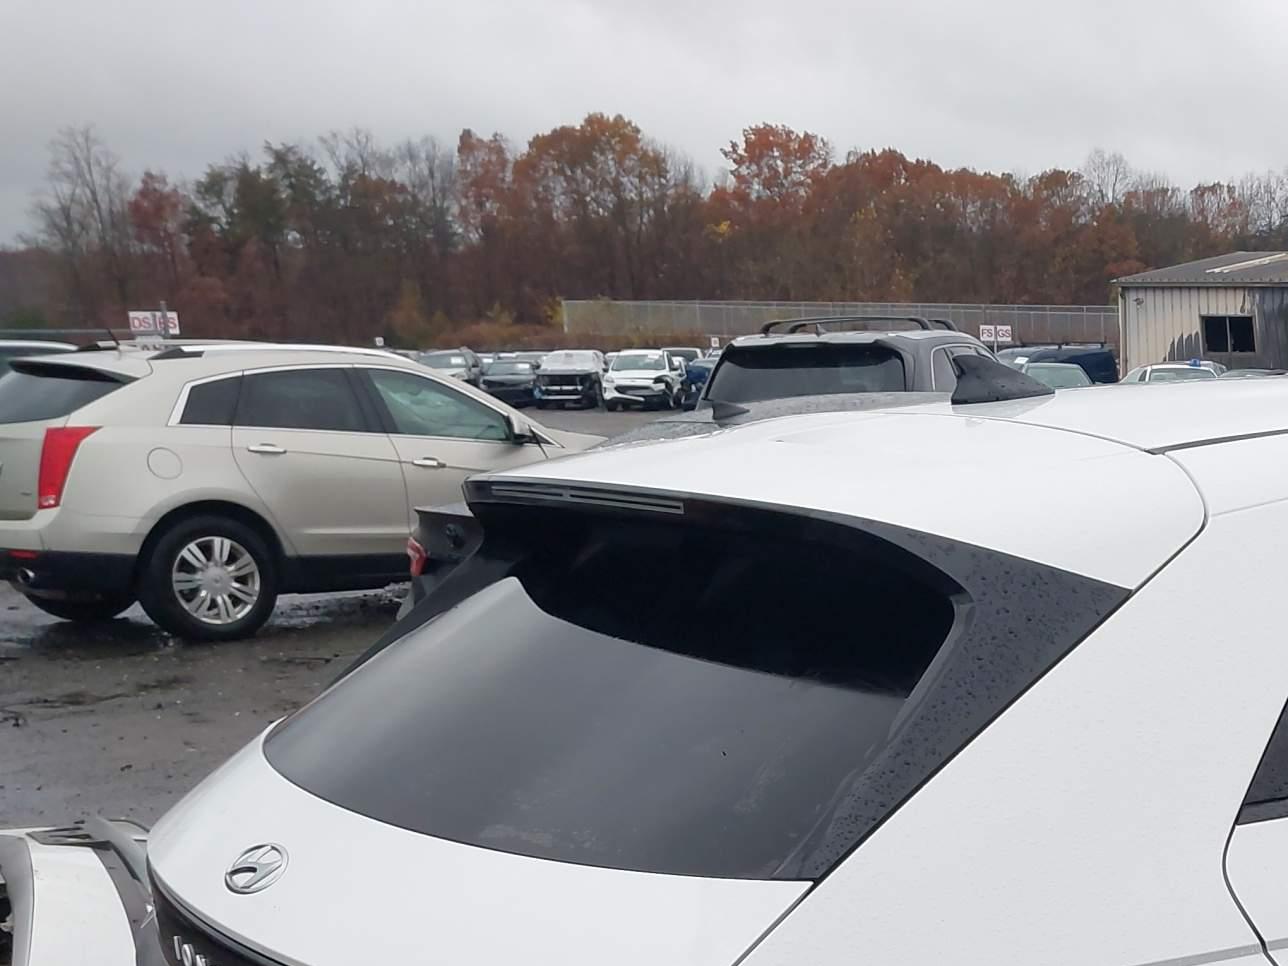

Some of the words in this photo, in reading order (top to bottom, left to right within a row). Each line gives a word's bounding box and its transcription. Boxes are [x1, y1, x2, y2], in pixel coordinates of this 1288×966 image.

[131, 316, 152, 329] DS
[981, 328, 993, 338] FS
[997, 328, 1011, 338] GS
